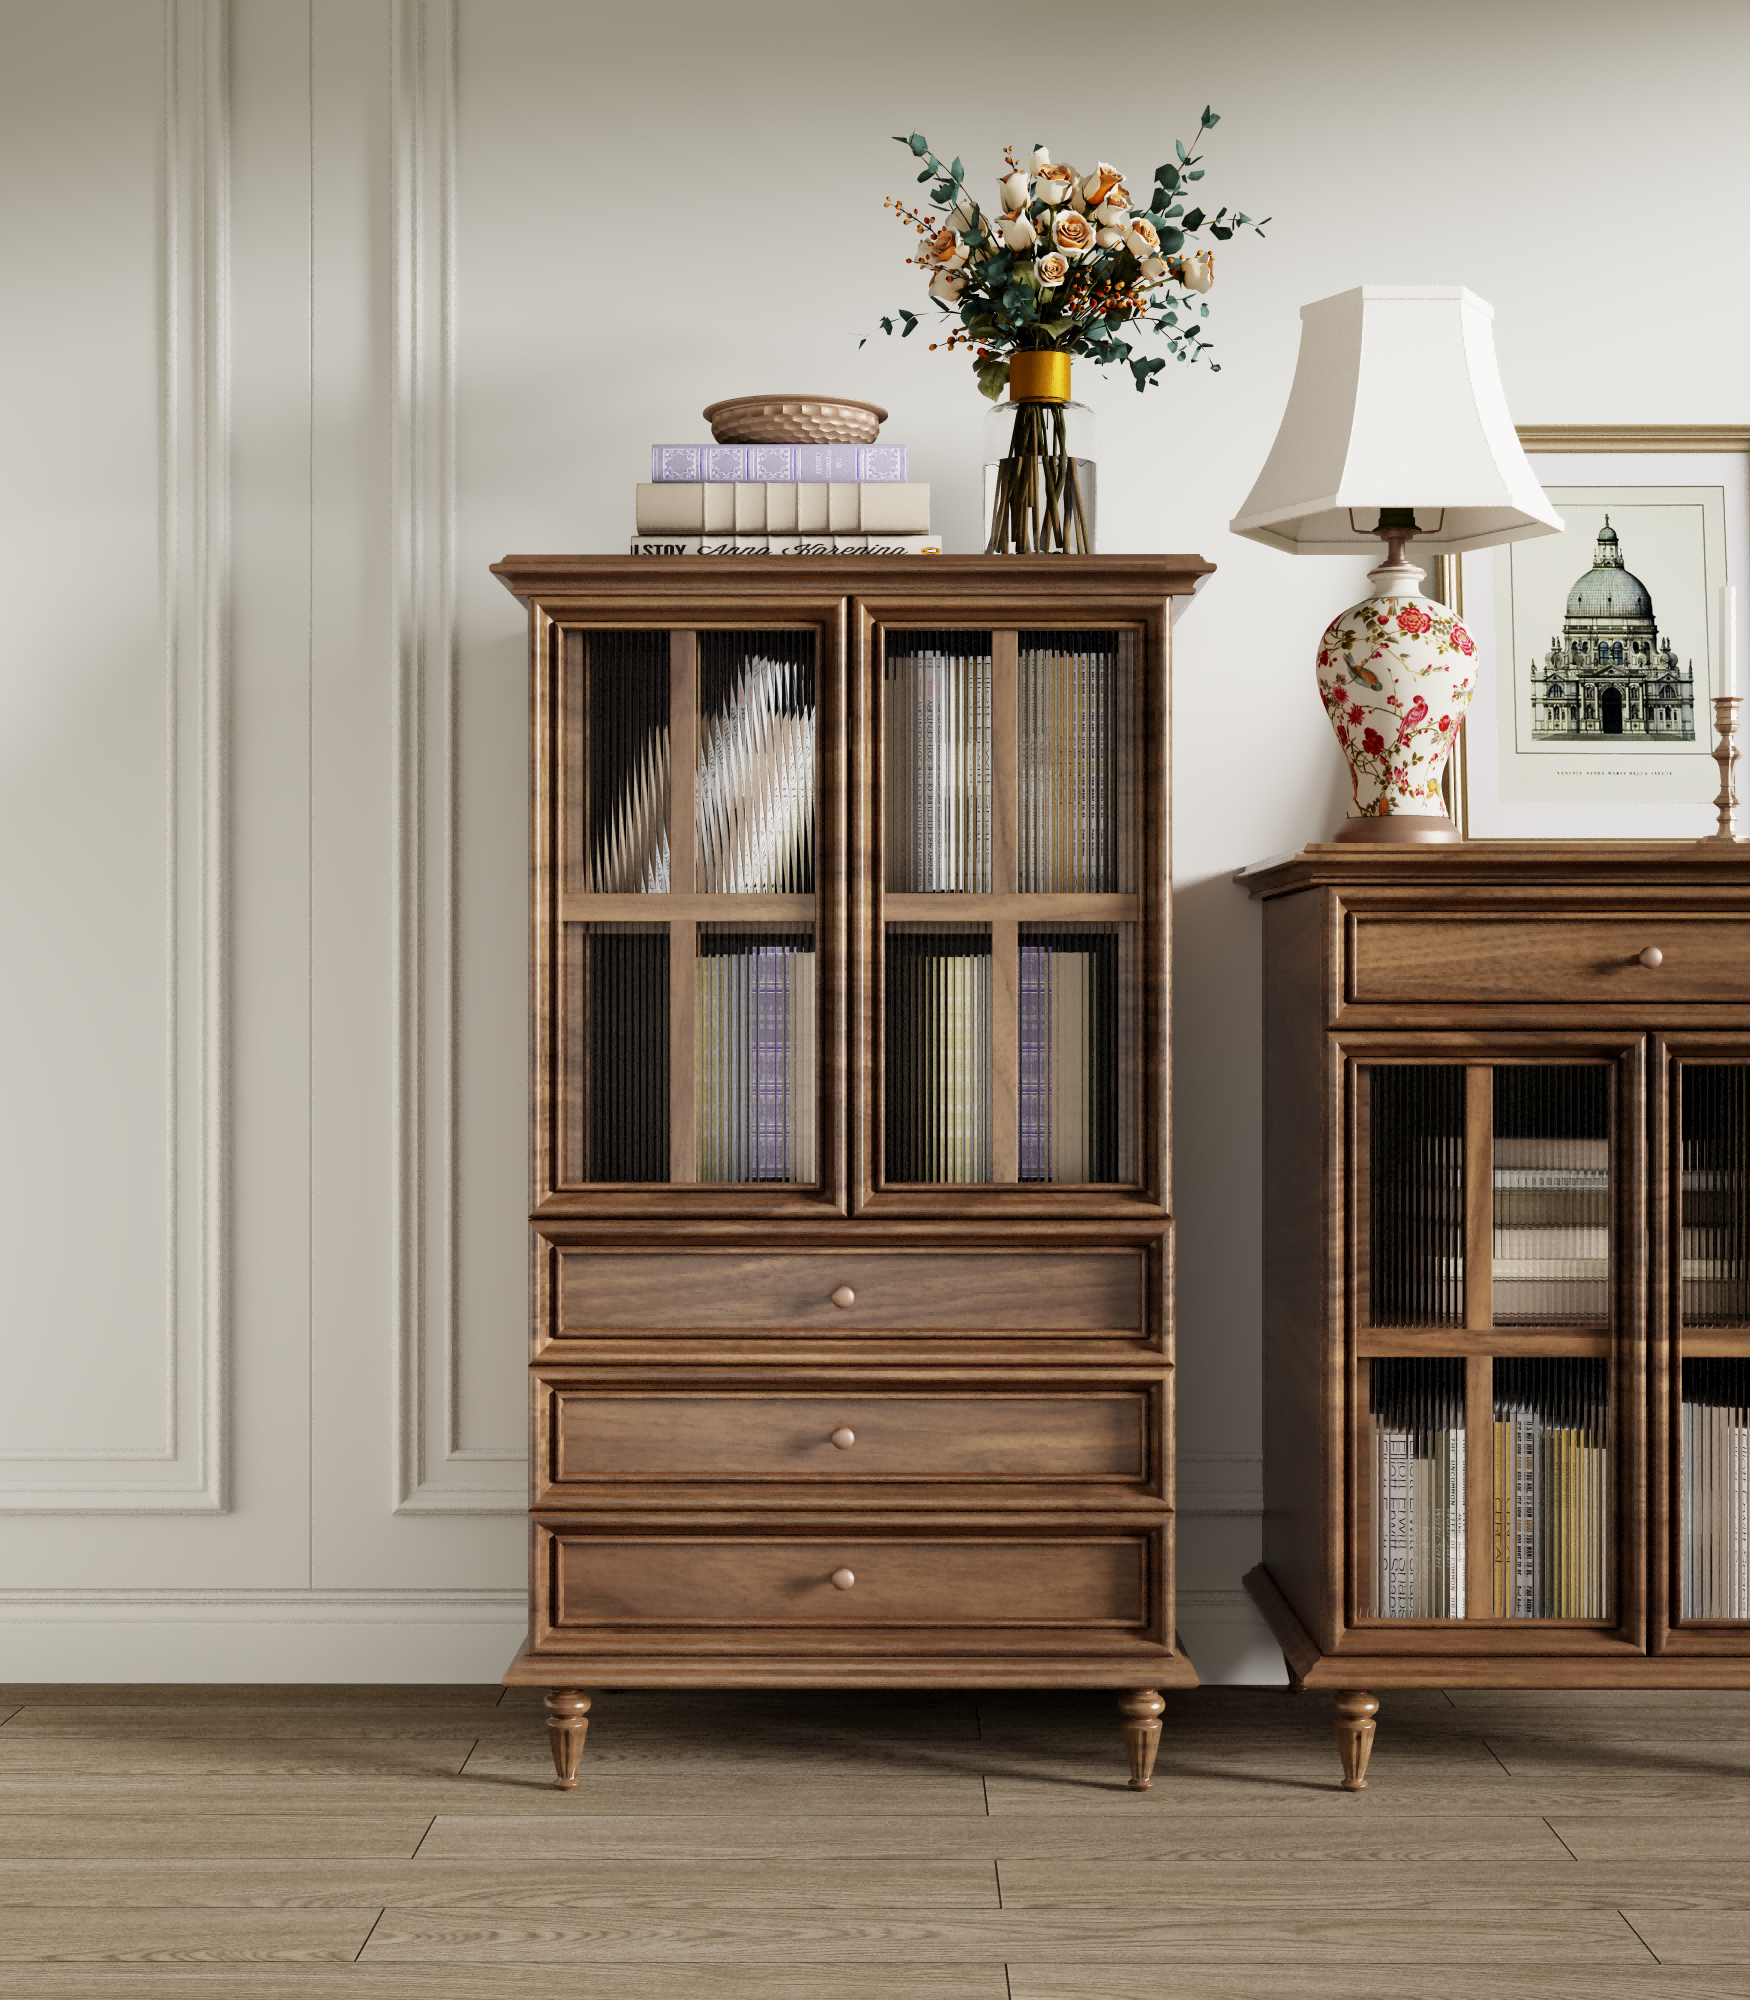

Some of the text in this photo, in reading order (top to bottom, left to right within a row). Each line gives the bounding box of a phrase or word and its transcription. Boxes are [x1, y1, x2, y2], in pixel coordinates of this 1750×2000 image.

[631, 543, 908, 555] LSTOY Anna Karenina
